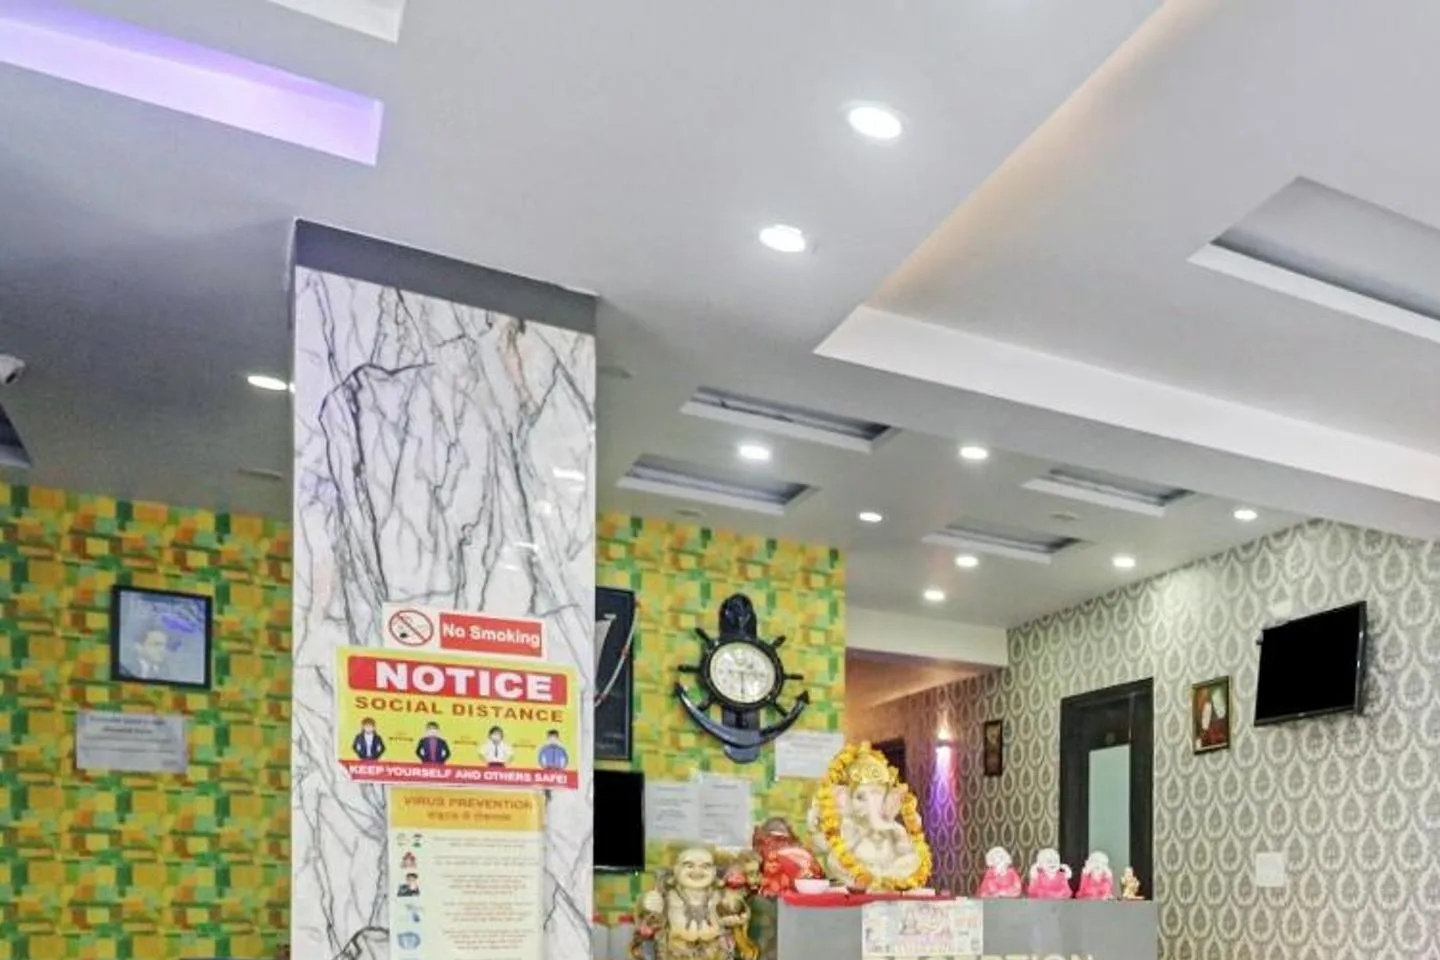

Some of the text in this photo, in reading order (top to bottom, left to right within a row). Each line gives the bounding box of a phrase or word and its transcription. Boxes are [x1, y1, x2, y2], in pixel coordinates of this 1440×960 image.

[442, 622, 541, 648] No Smoking
[376, 661, 552, 701] NOTICE
[354, 696, 563, 723] SOCIAL DISTANCE
[351, 765, 567, 784] KEEP YOURSELF AND OTHERS SAFE!
